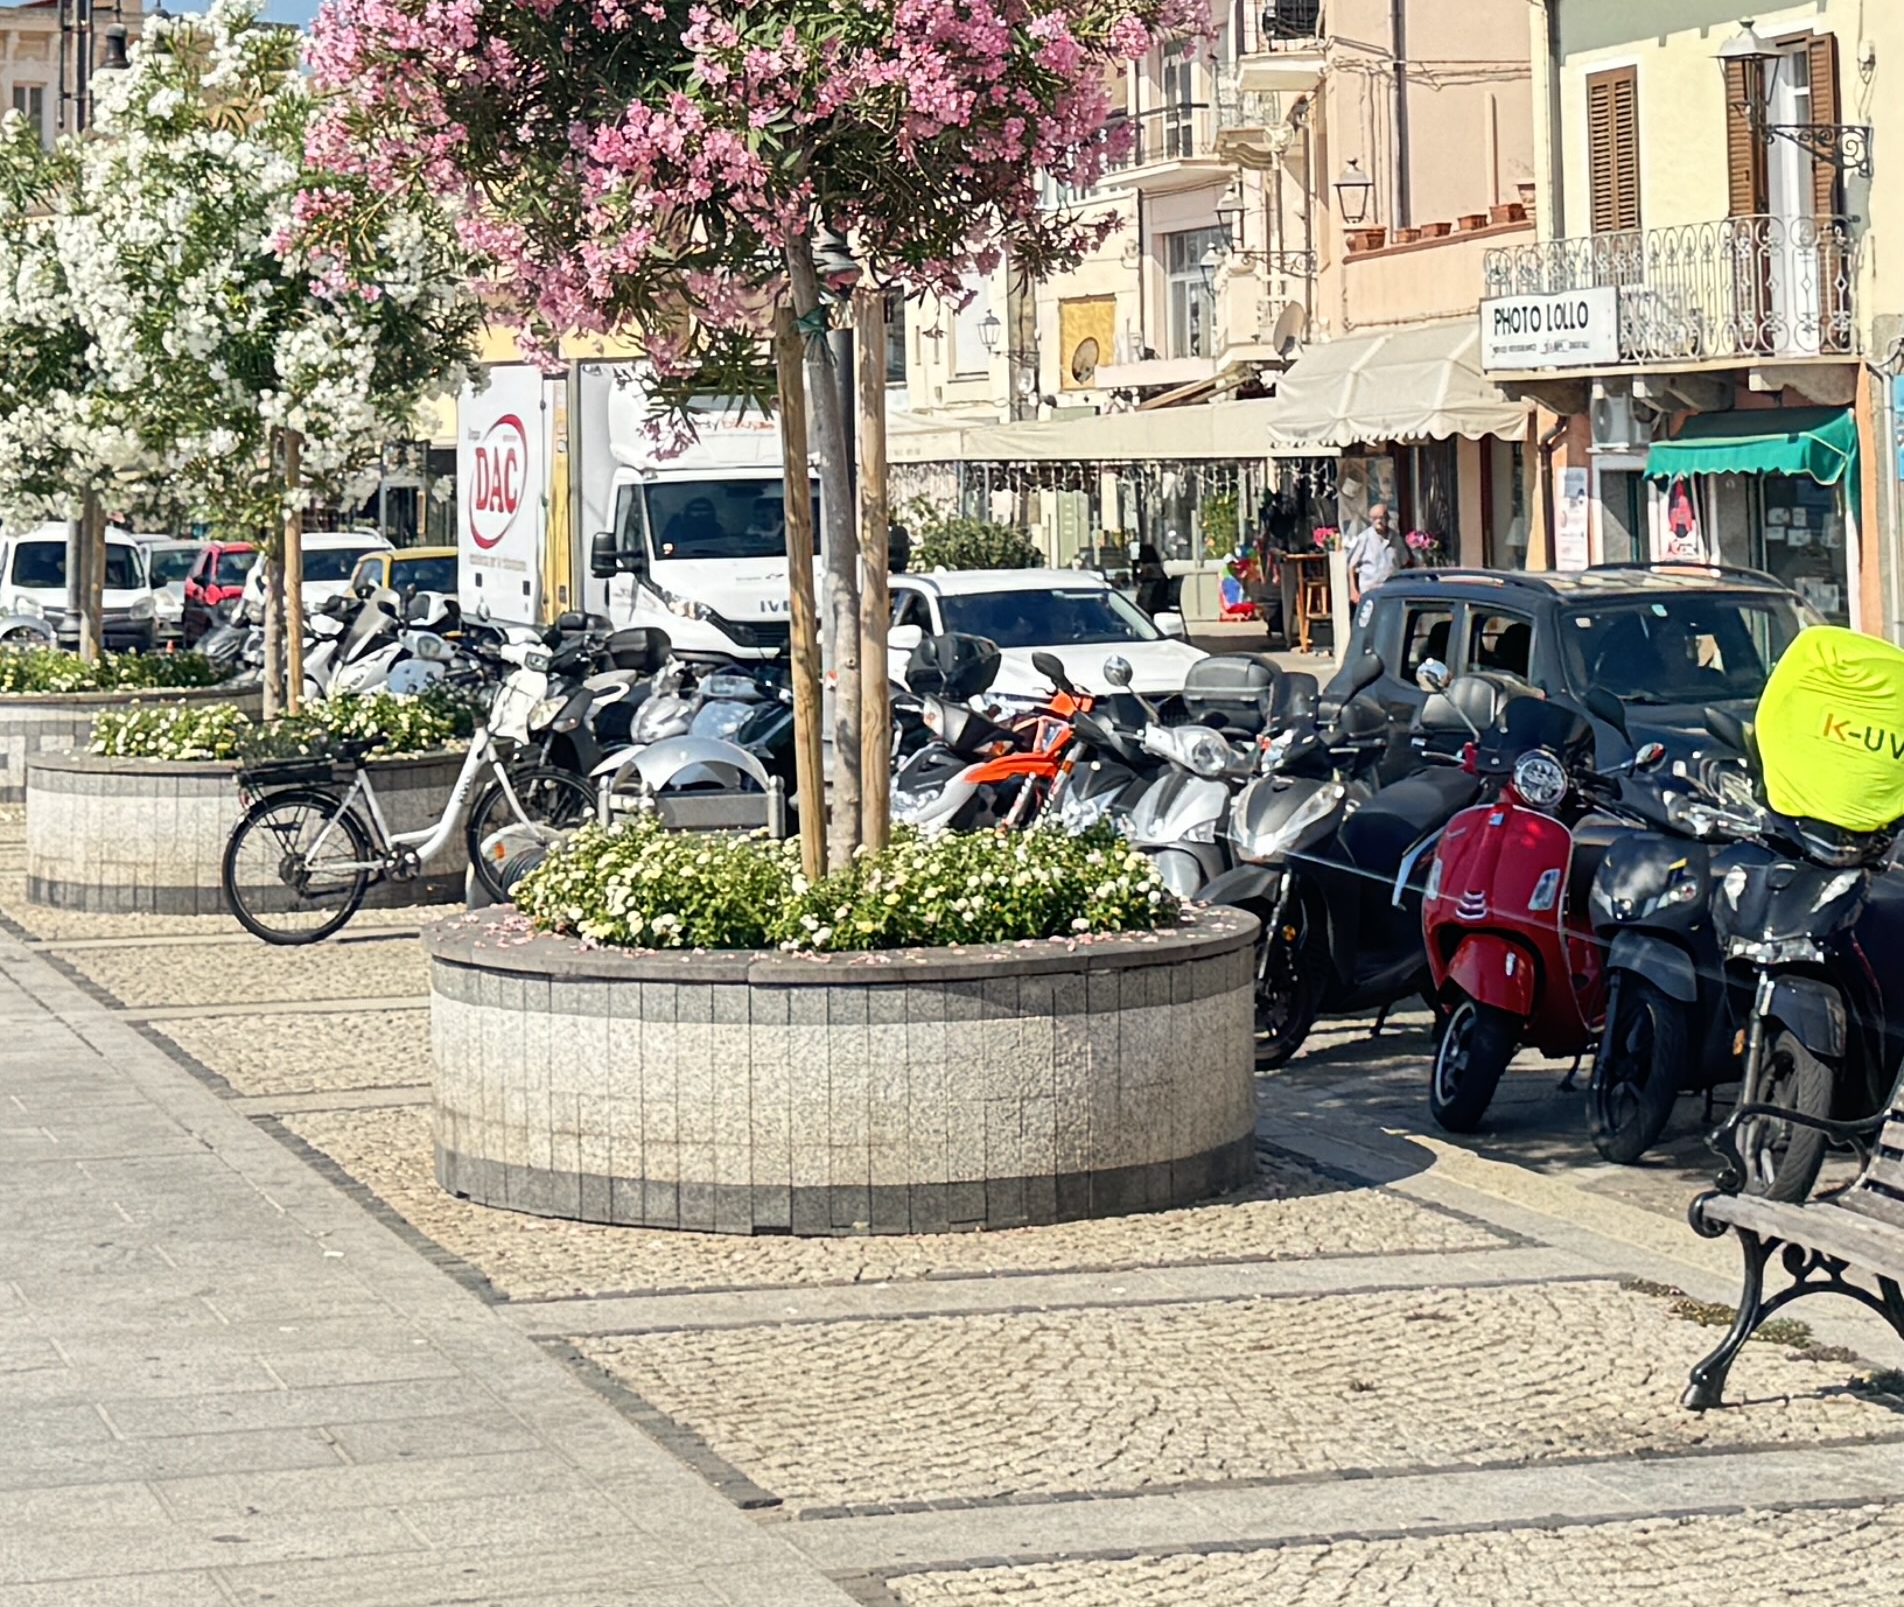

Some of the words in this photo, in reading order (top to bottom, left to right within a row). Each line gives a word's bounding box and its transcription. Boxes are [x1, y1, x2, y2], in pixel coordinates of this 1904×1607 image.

[1494, 304, 1542, 336] PHOTO
[1547, 301, 1589, 331] LOLLO
[474, 446, 518, 514] DAC
